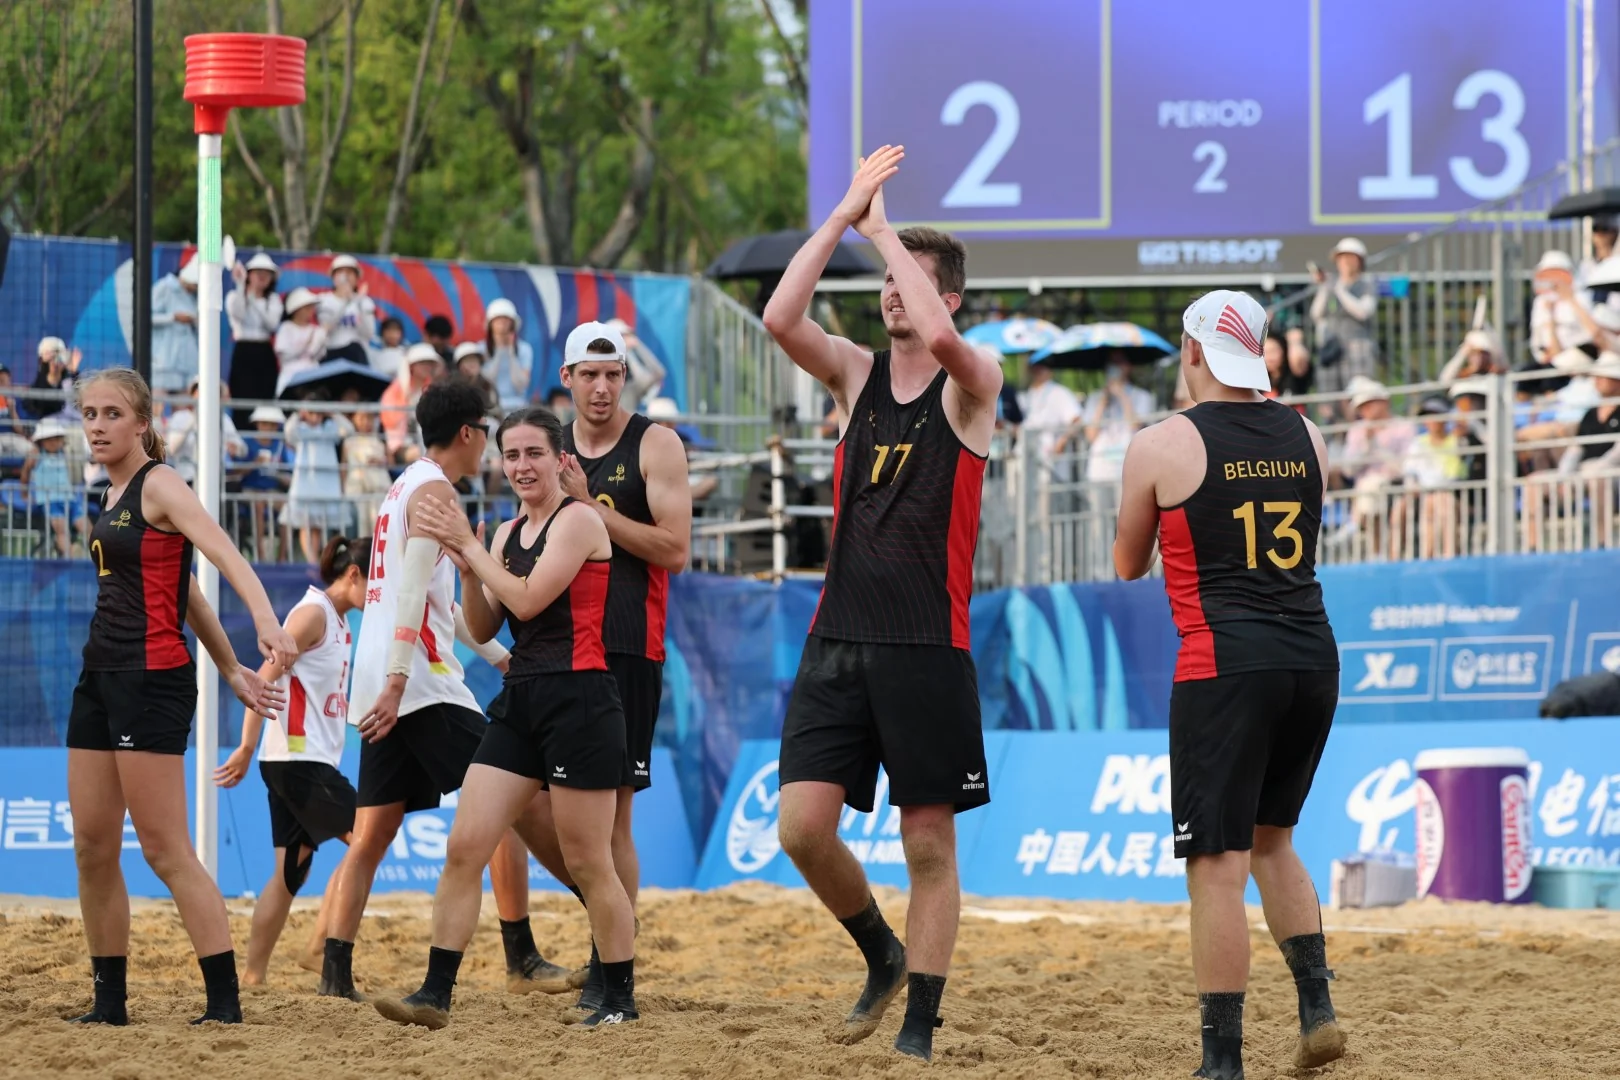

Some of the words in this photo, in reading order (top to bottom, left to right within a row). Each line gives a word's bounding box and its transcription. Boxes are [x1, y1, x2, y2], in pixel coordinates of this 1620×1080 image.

[1158, 98, 1262, 128] PERIOD
[941, 81, 1021, 208] 2
[1359, 69, 1530, 200] 13
[1193, 141, 1228, 193] 2
[870, 443, 913, 486] 17
[1224, 460, 1306, 480] BELGIUM
[1233, 501, 1303, 569] 13
[91, 540, 112, 576] 2
[962, 782, 985, 790] erima
[1175, 833, 1192, 842] erima
